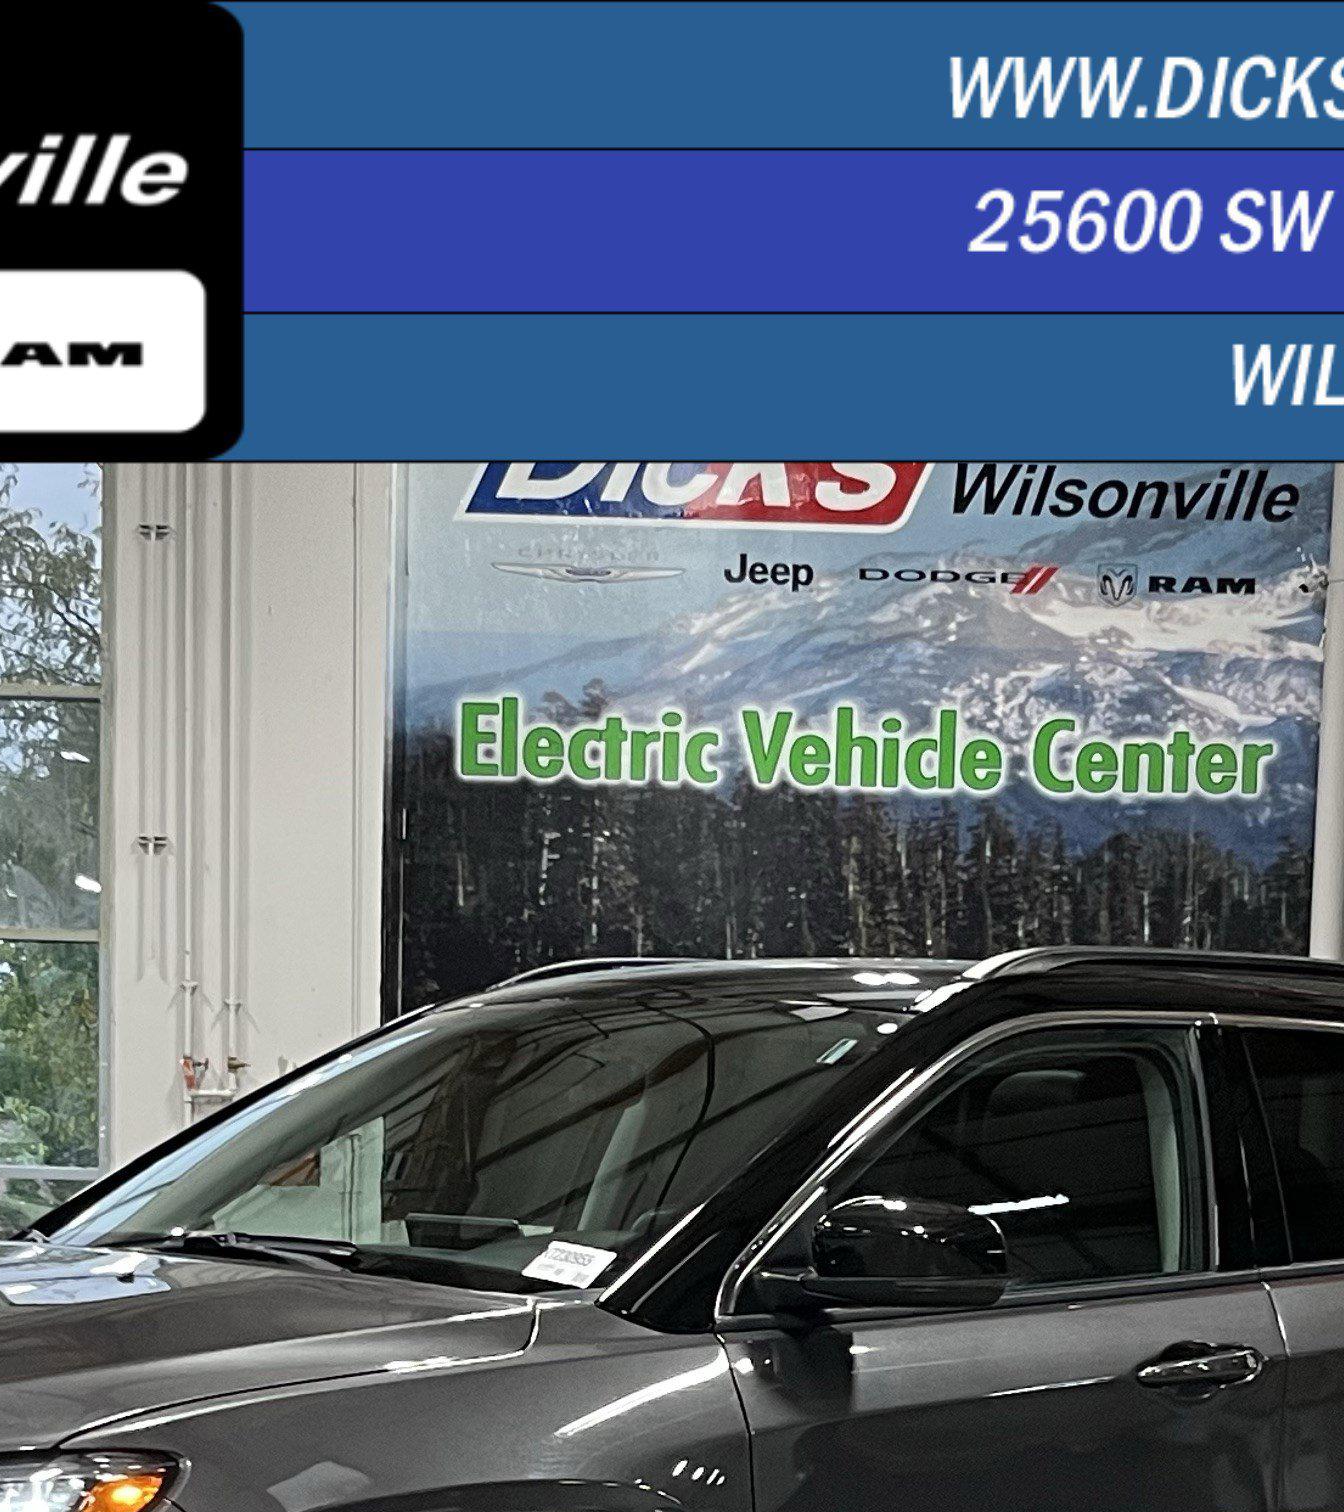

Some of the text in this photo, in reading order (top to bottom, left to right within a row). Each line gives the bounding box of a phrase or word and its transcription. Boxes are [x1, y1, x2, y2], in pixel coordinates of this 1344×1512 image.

[952, 461, 1301, 523] Wilsonville
[723, 552, 815, 592] Jeep
[858, 567, 1026, 585] DODGE
[1148, 574, 1257, 596] RAM
[460, 698, 1271, 793] Electric Vehicle Center
